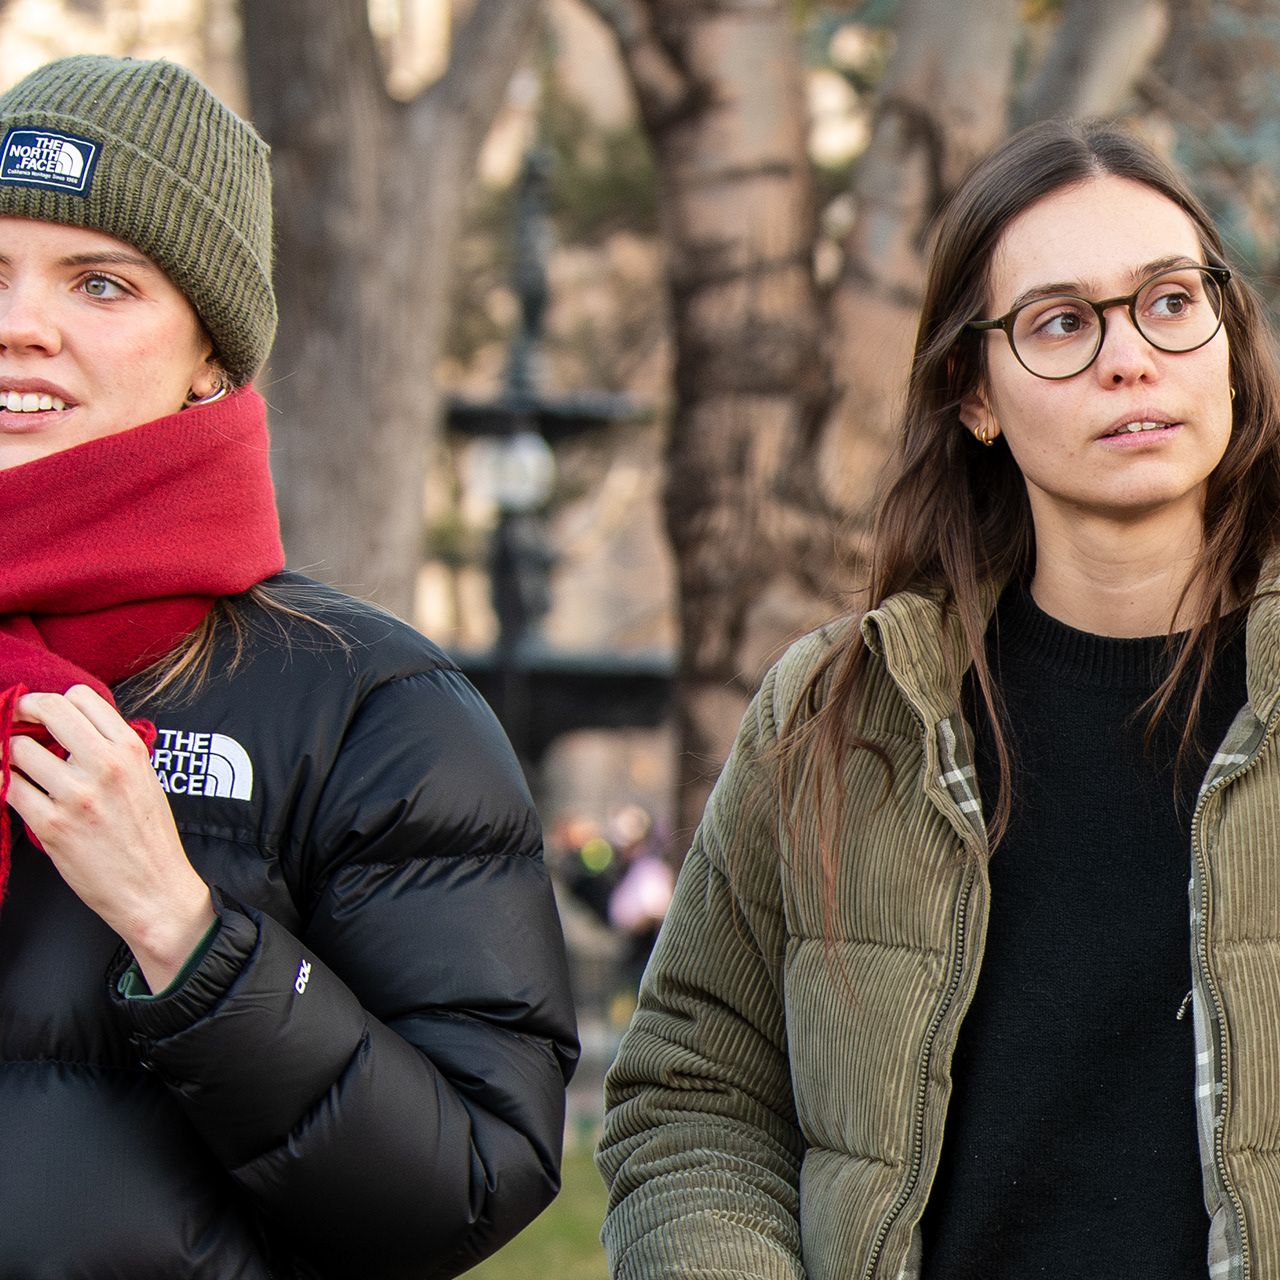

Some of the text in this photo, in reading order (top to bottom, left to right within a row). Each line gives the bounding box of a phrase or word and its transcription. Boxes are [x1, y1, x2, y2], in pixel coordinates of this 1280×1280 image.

[9, 144, 60, 161] NORTH
[36, 137, 63, 150] THE
[20, 157, 56, 173] FACE
[158, 728, 211, 753] THE
[149, 748, 208, 774] RTH
[158, 769, 206, 796] ACE
